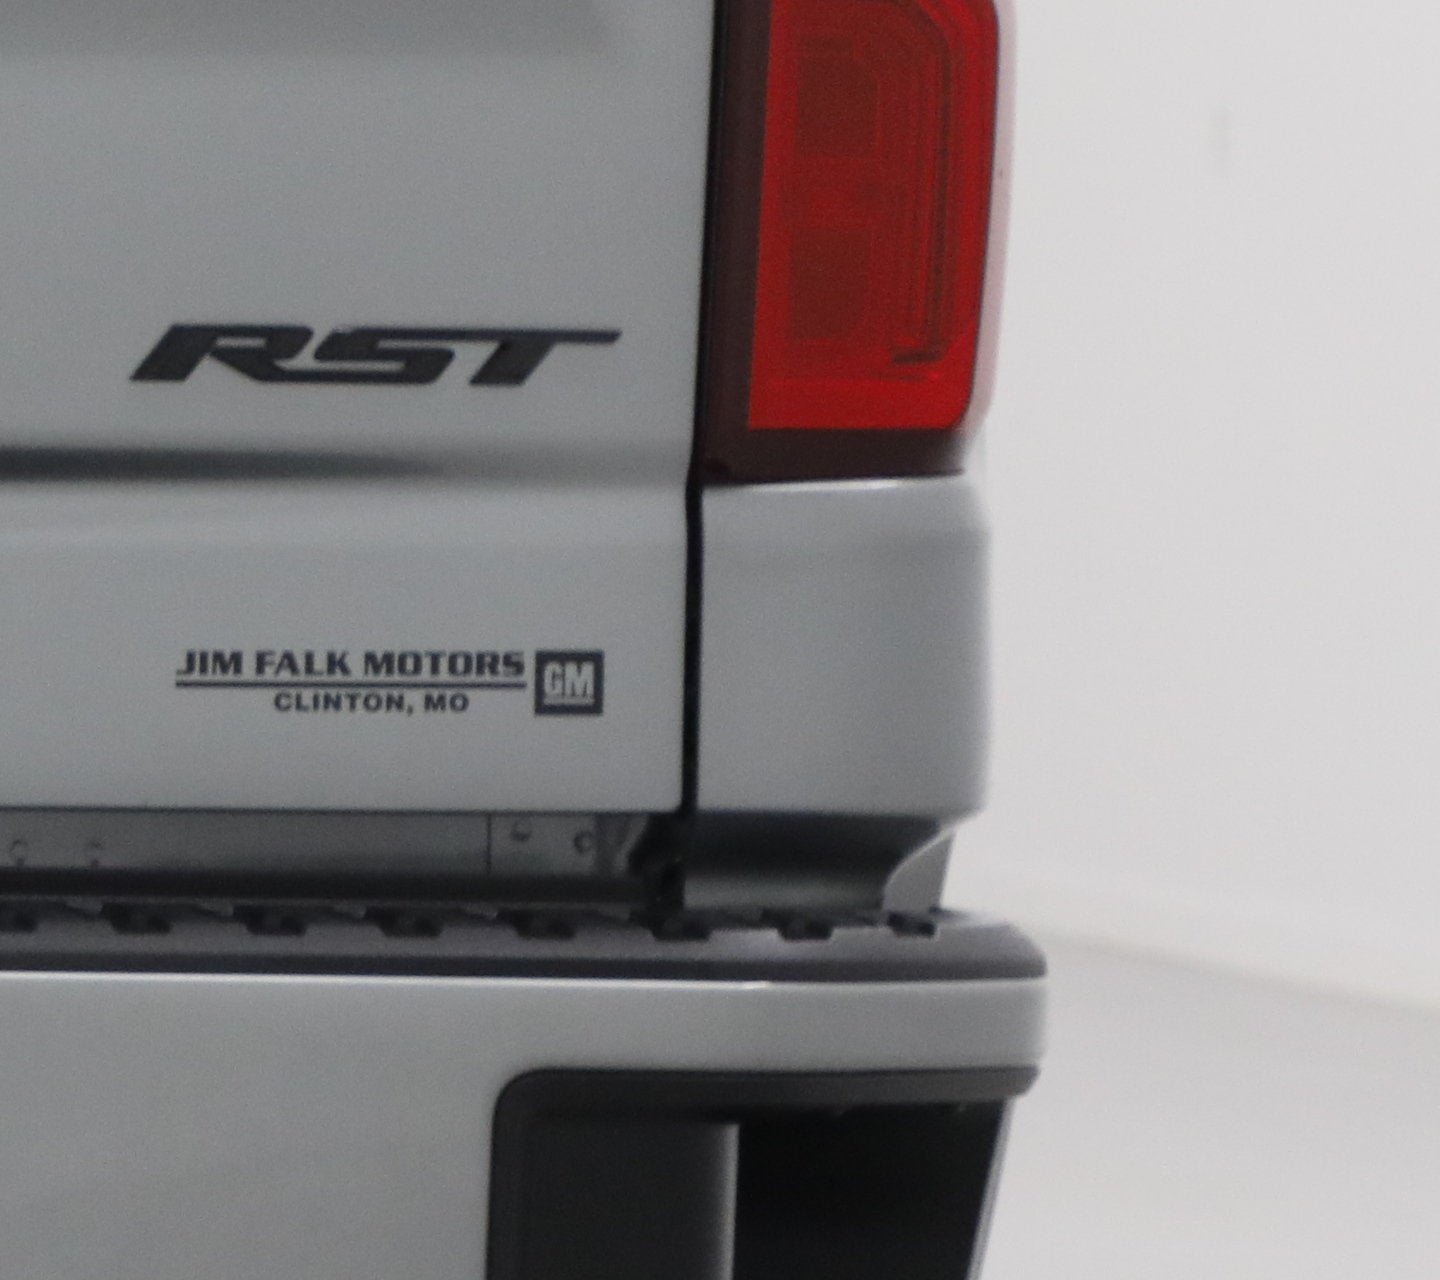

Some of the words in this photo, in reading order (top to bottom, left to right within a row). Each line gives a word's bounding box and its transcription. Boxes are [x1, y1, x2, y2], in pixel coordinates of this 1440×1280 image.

[128, 322, 623, 388] RST
[175, 649, 244, 678] JIM
[253, 649, 352, 678] FALK
[362, 649, 526, 679] MOTORS
[273, 691, 415, 717] CLINTON,
[423, 691, 470, 714] MO
